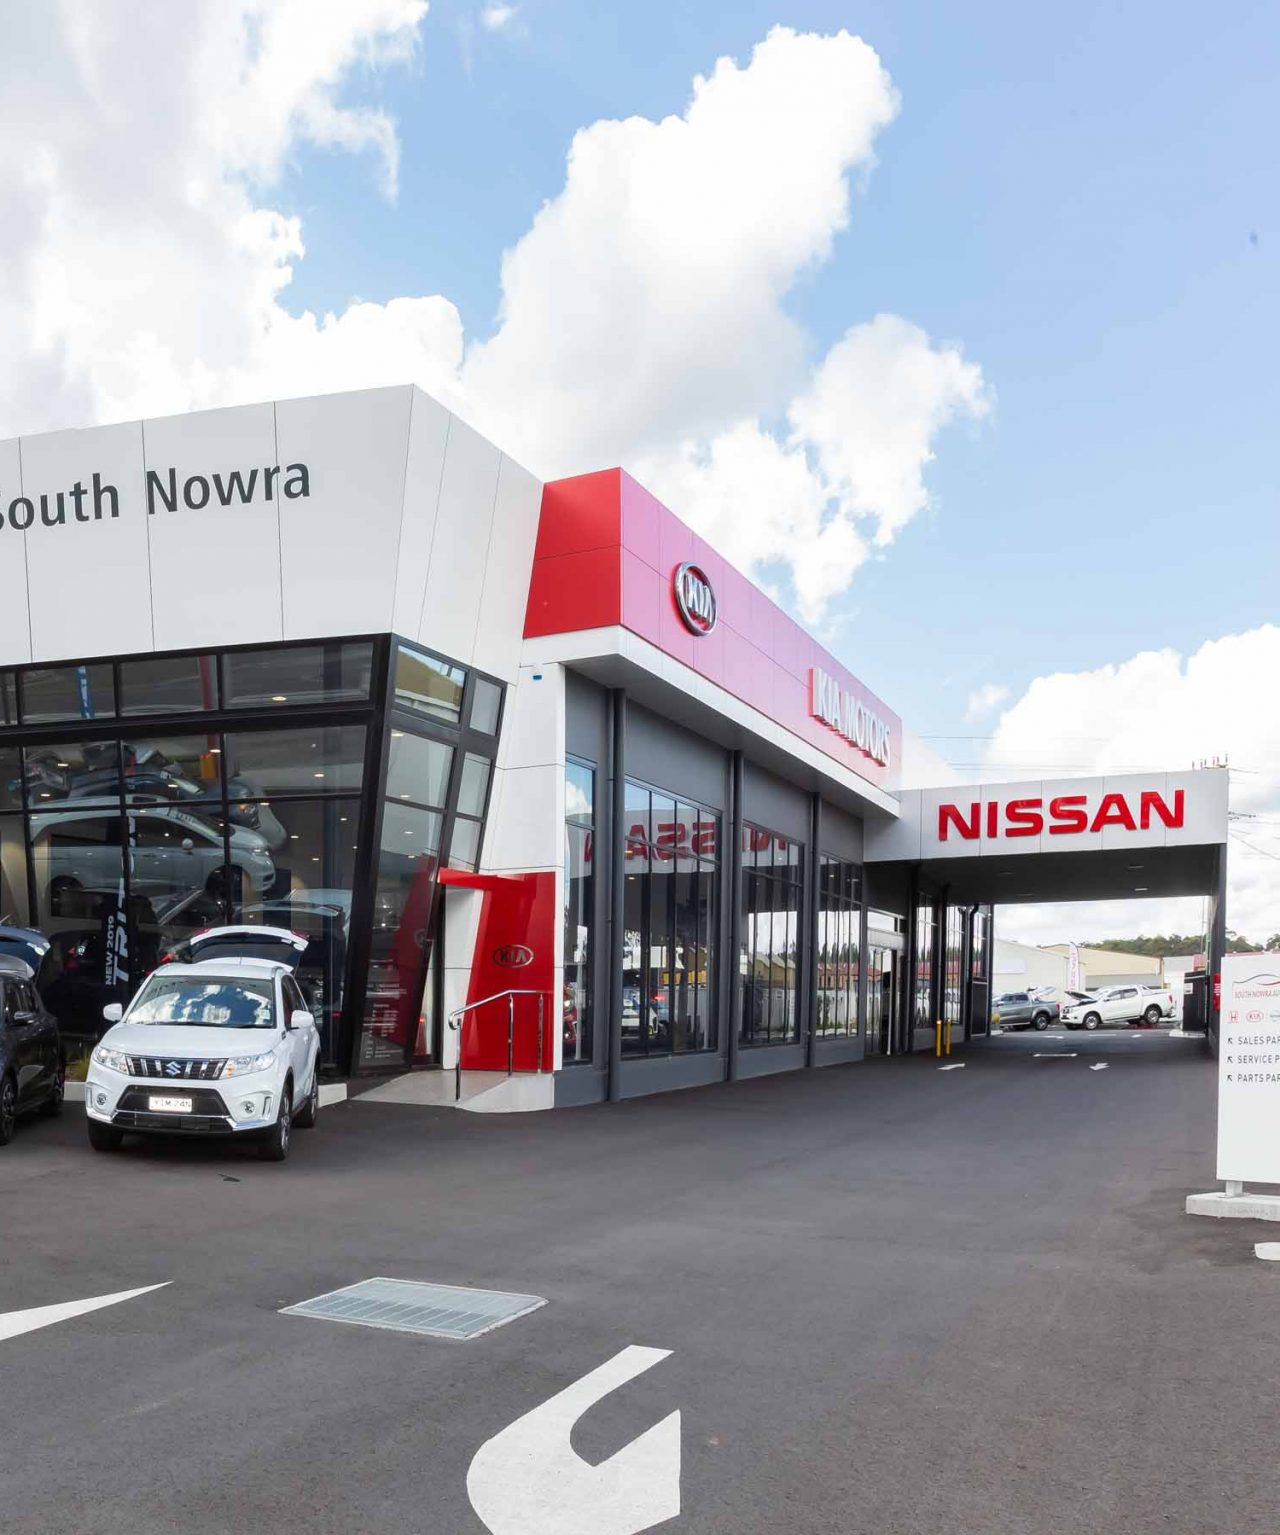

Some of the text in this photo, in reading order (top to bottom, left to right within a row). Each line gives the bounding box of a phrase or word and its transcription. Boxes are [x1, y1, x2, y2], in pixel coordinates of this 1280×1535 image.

[147, 463, 311, 515] Nowra
[811, 667, 891, 768] KIA MOTORS
[938, 789, 1185, 842] NISSAN
[105, 915, 115, 985] NEW 2019
[1237, 1054, 1273, 1064] SERVICE
[1238, 1036, 1264, 1045] SALES
[1237, 1073, 1264, 1083] PARTS
